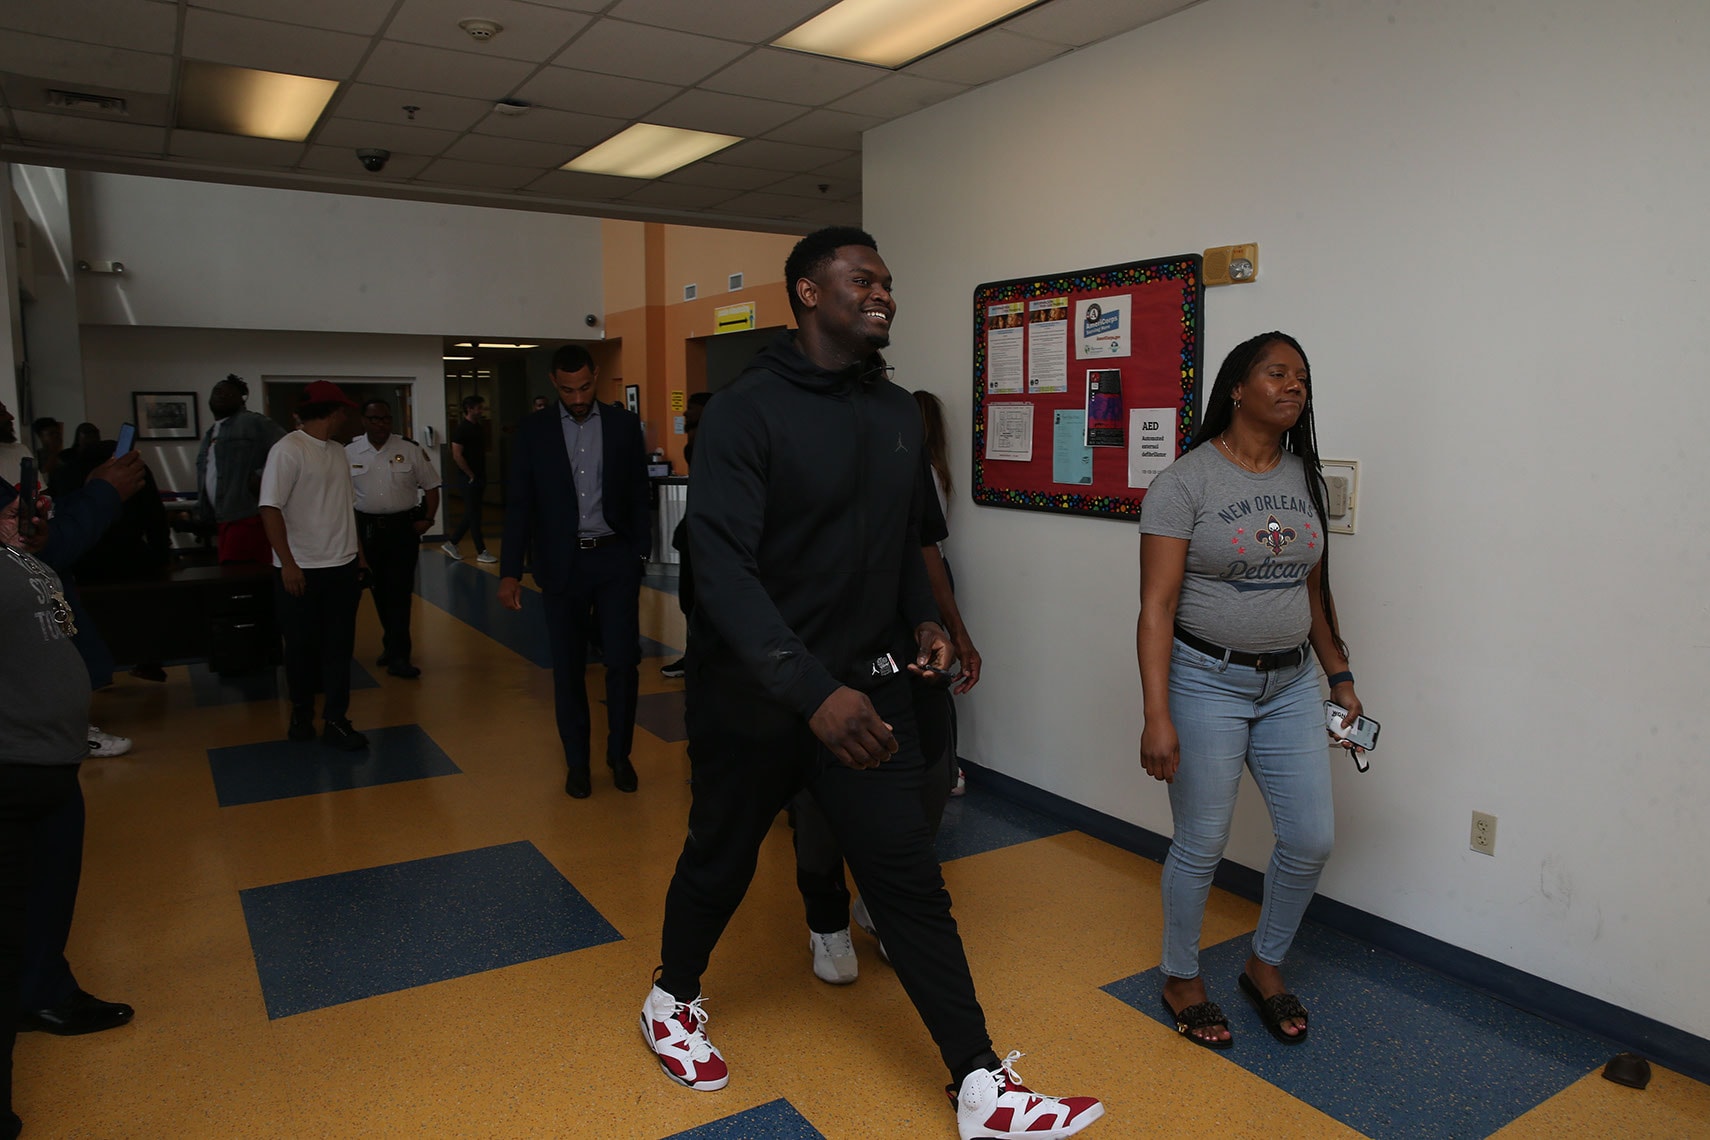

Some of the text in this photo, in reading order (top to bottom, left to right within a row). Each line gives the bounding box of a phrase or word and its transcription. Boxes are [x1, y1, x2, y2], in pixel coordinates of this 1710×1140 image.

[1142, 421, 1159, 431] AED
[1217, 495, 1314, 525] NEW ORLEANS
